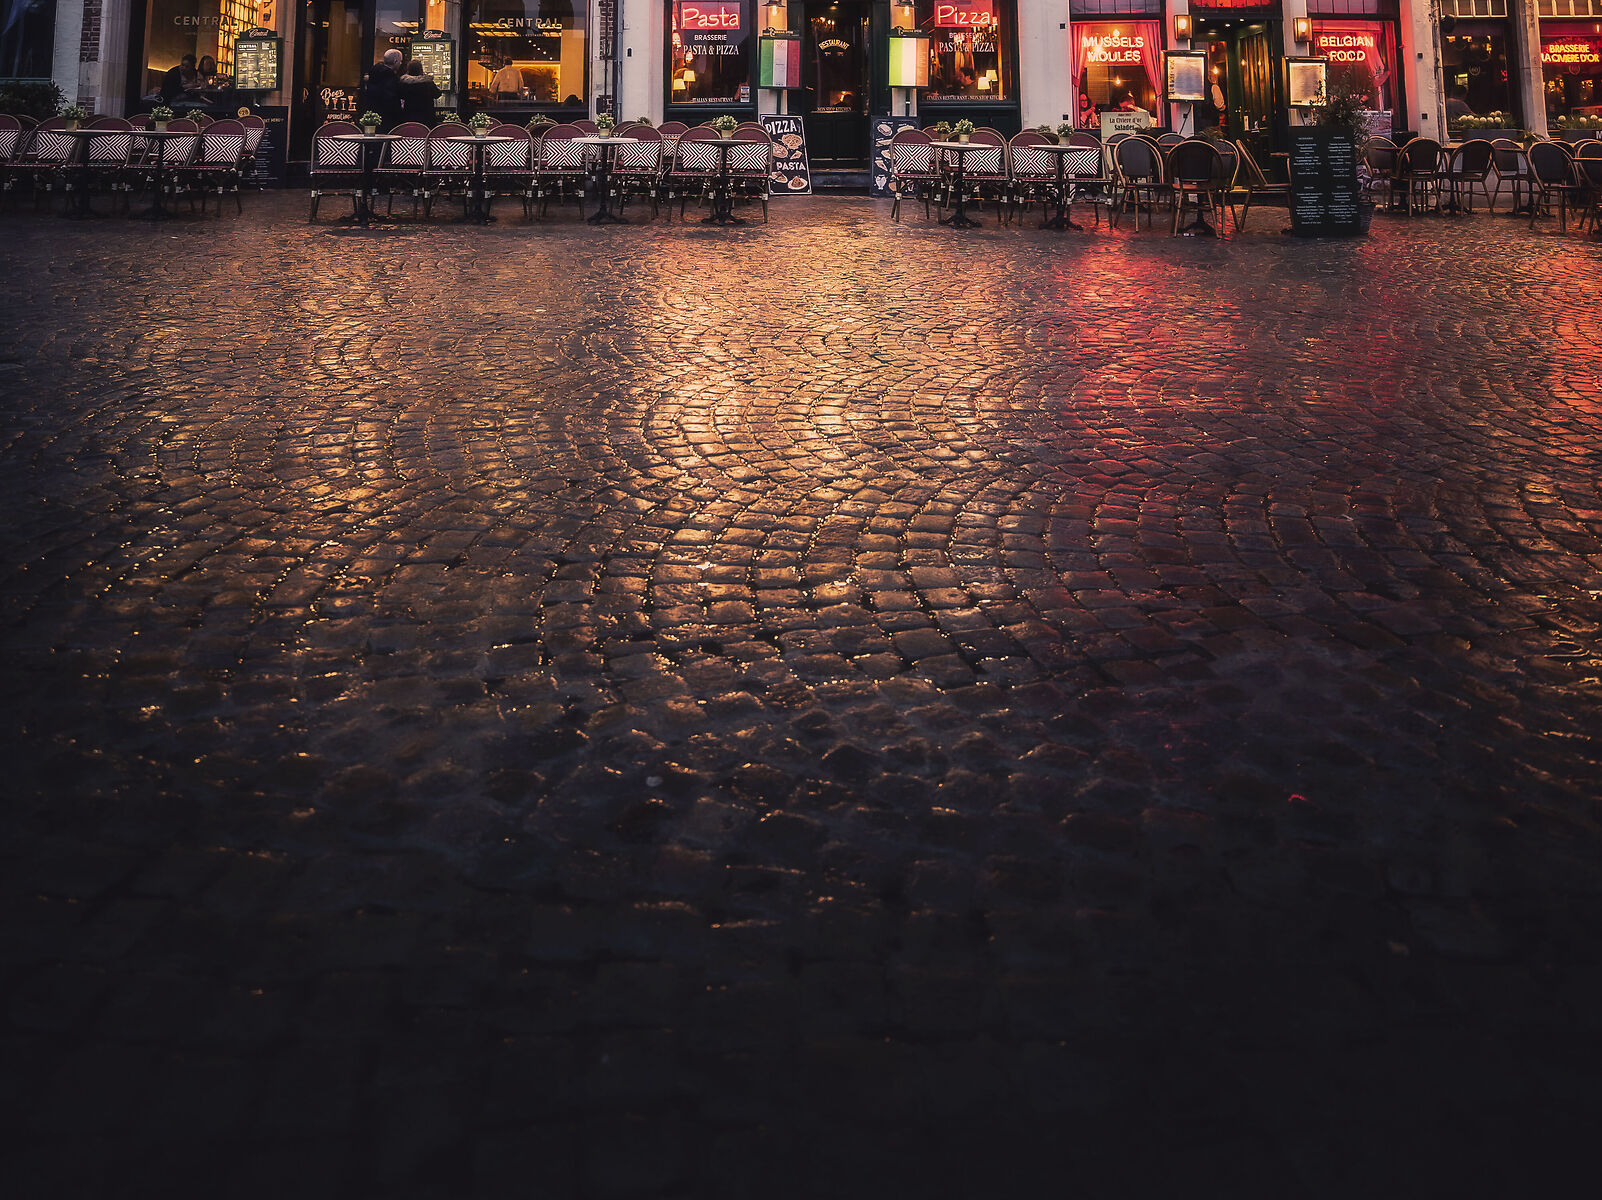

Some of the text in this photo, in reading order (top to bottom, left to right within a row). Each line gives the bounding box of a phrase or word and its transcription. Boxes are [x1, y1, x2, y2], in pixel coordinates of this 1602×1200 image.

[682, 6, 739, 28] Pasta
[937, 5, 991, 25] Pizza
[173, 16, 239, 27] CENTRAL
[497, 17, 561, 28] CENTRAL
[938, 41, 964, 53] PASTA
[971, 41, 995, 53] PIZZA
[1081, 35, 1145, 48] MUSSELS
[1319, 35, 1374, 48] BELGIAN
[683, 44, 740, 56] PASTA & PIZZA
[764, 119, 798, 135] PIZZA
[776, 161, 806, 171] PASTA
